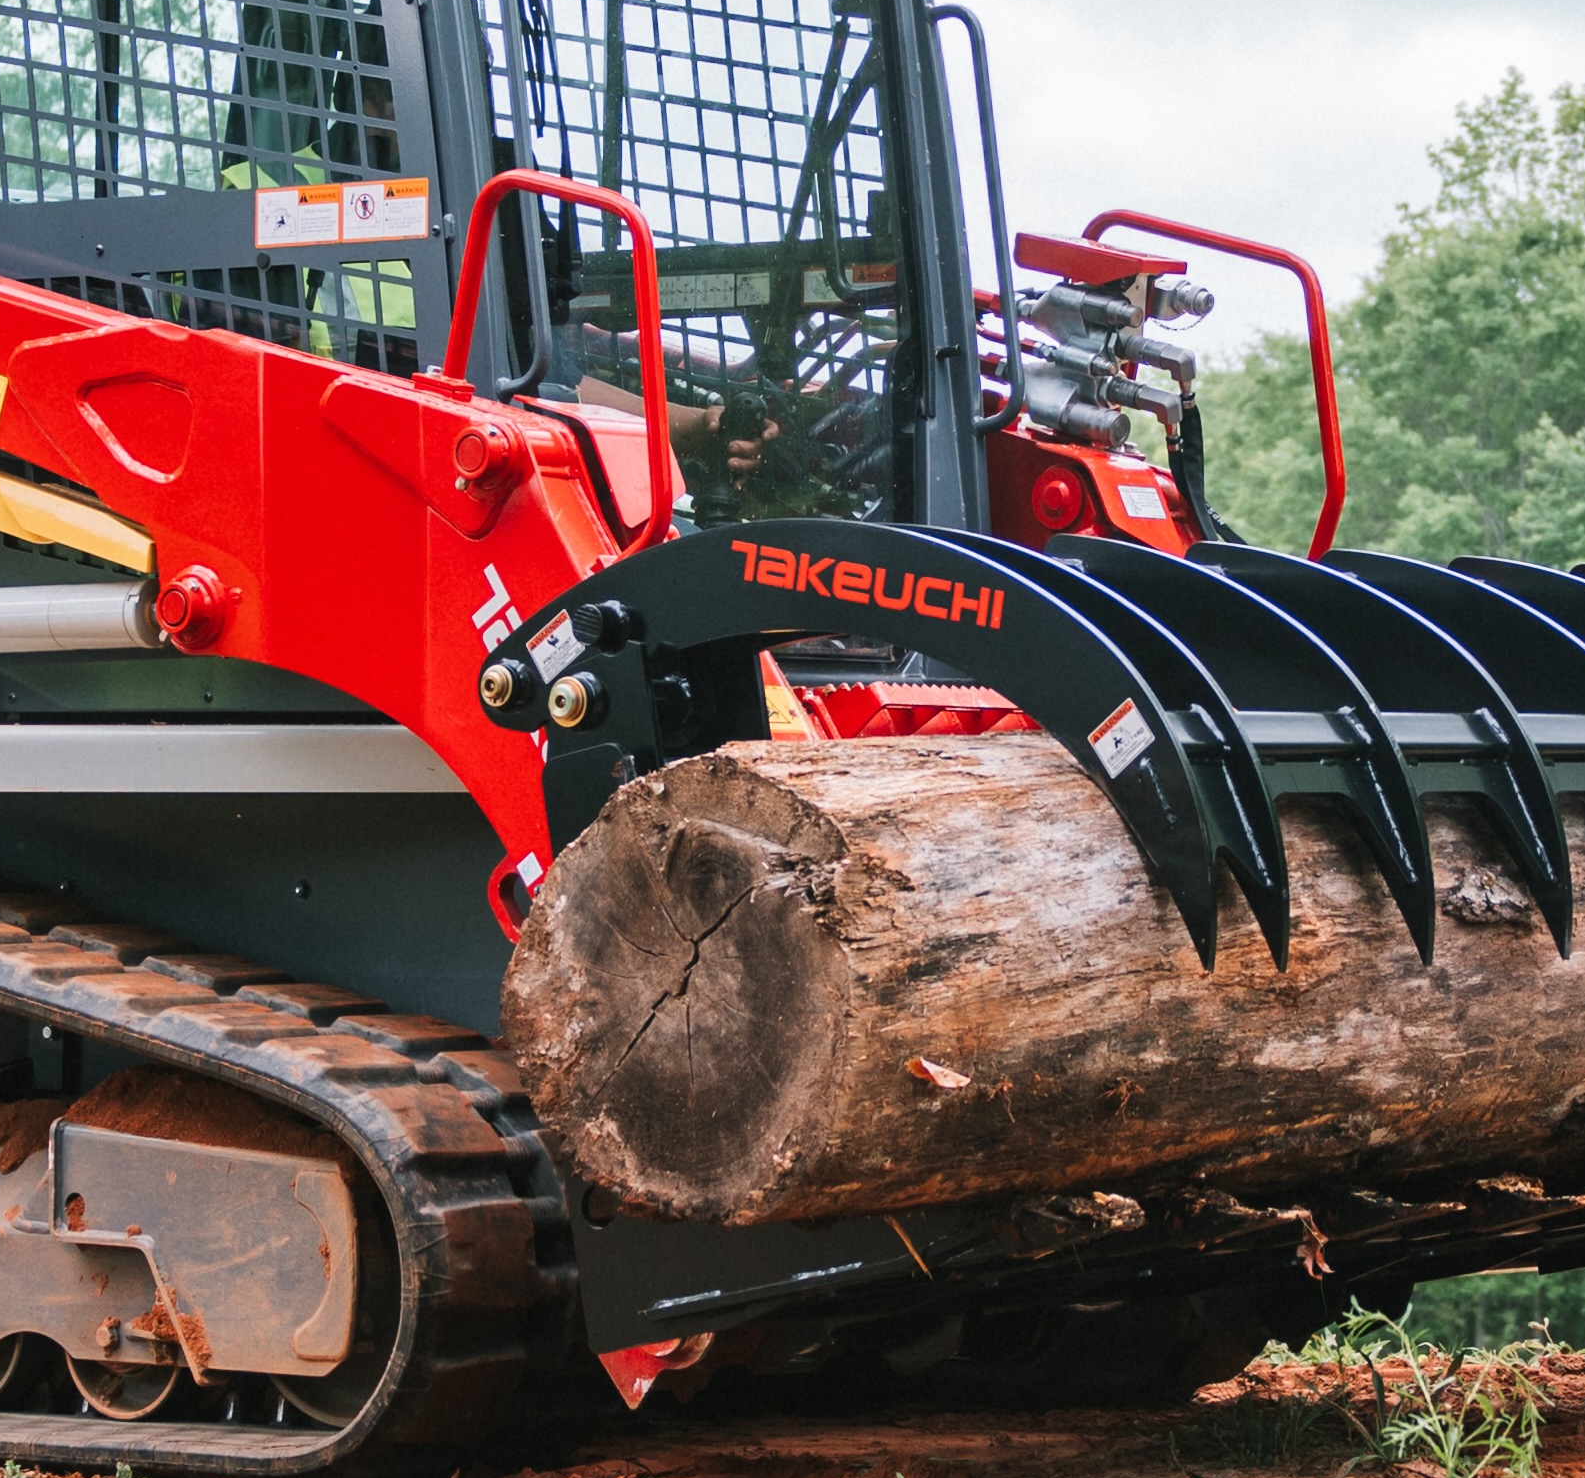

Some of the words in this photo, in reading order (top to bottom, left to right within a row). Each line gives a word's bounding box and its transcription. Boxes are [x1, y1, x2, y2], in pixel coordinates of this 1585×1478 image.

[731, 540, 1005, 630] TAKEUCHI
[531, 611, 567, 645] WARNING
[1097, 701, 1132, 736] WARNING
